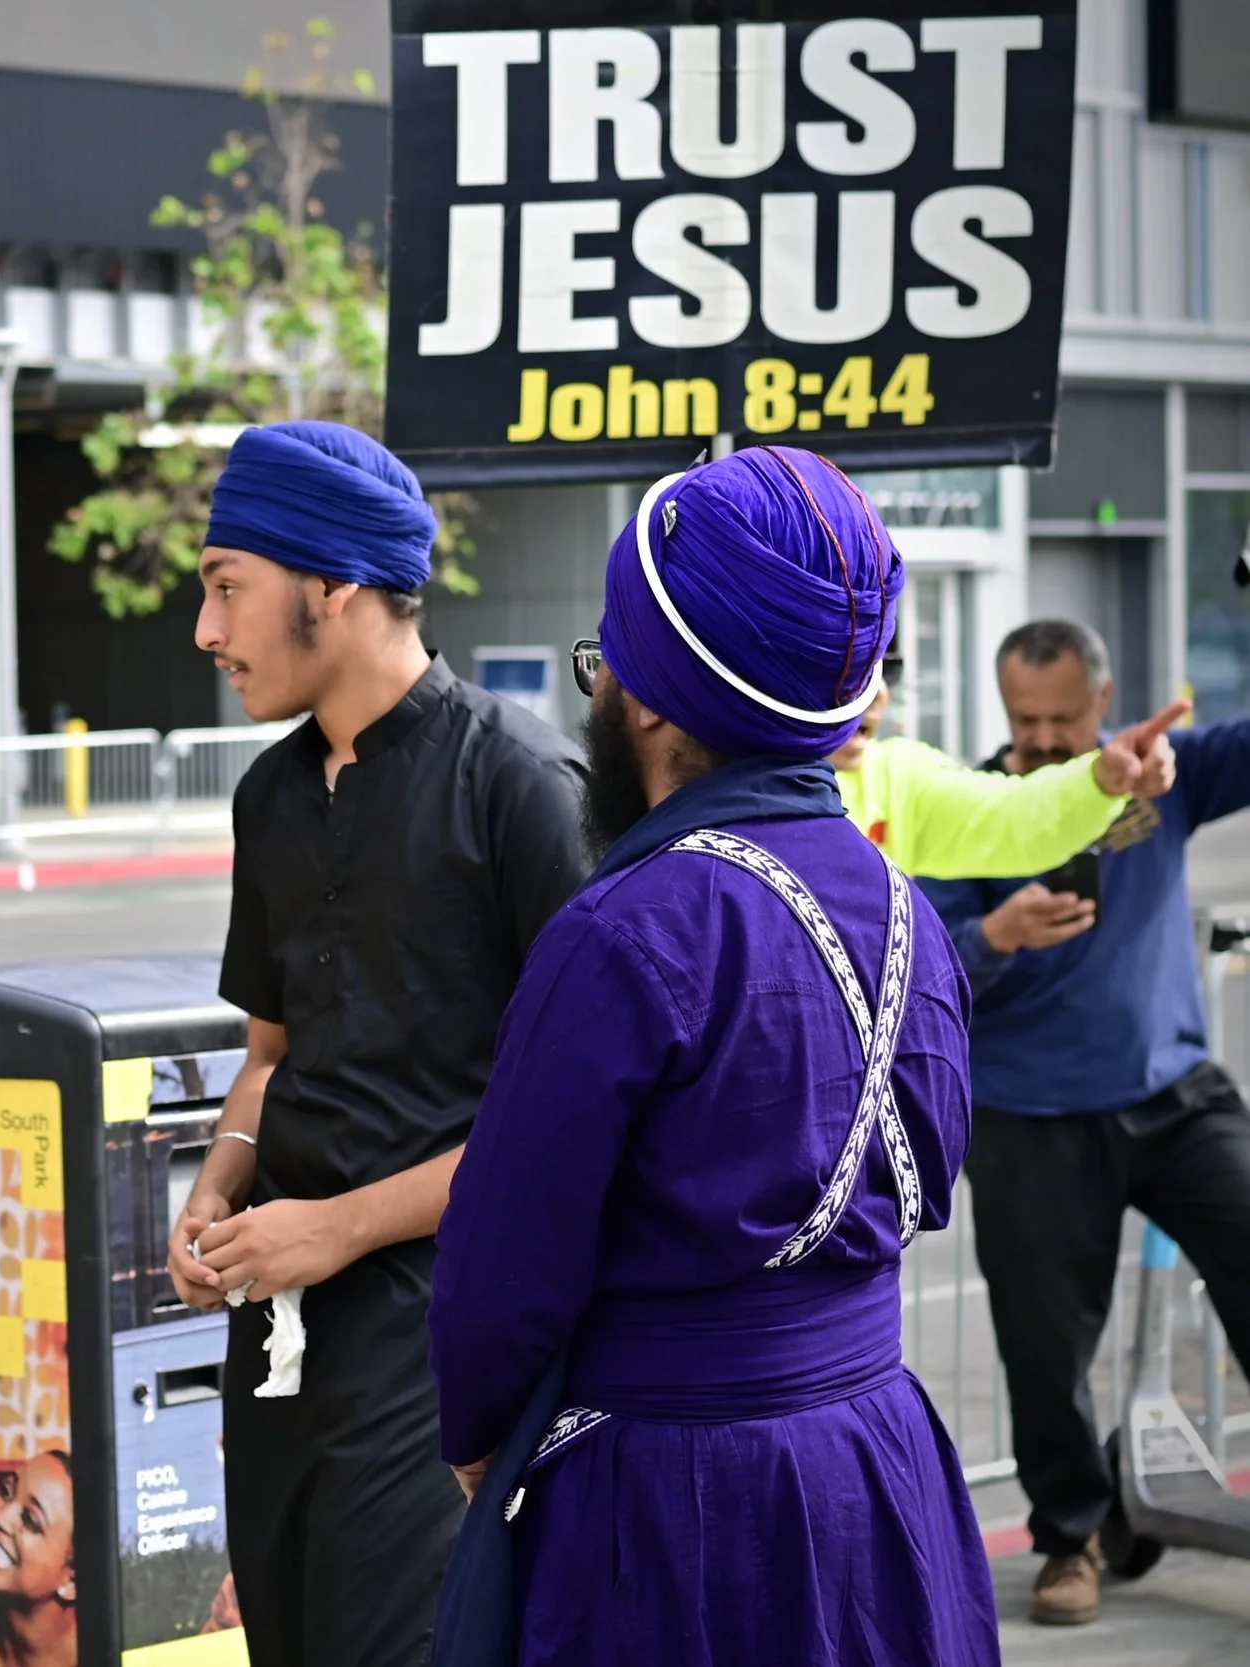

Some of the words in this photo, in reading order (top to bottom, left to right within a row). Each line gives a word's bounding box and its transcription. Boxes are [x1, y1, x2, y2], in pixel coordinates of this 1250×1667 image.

[422, 15, 1043, 187] TRUST
[417, 185, 1034, 356] JESUS
[507, 366, 718, 443] John
[743, 353, 934, 433] 8:44
[0, 1109, 49, 1132] South
[34, 1135, 50, 1189] Park
